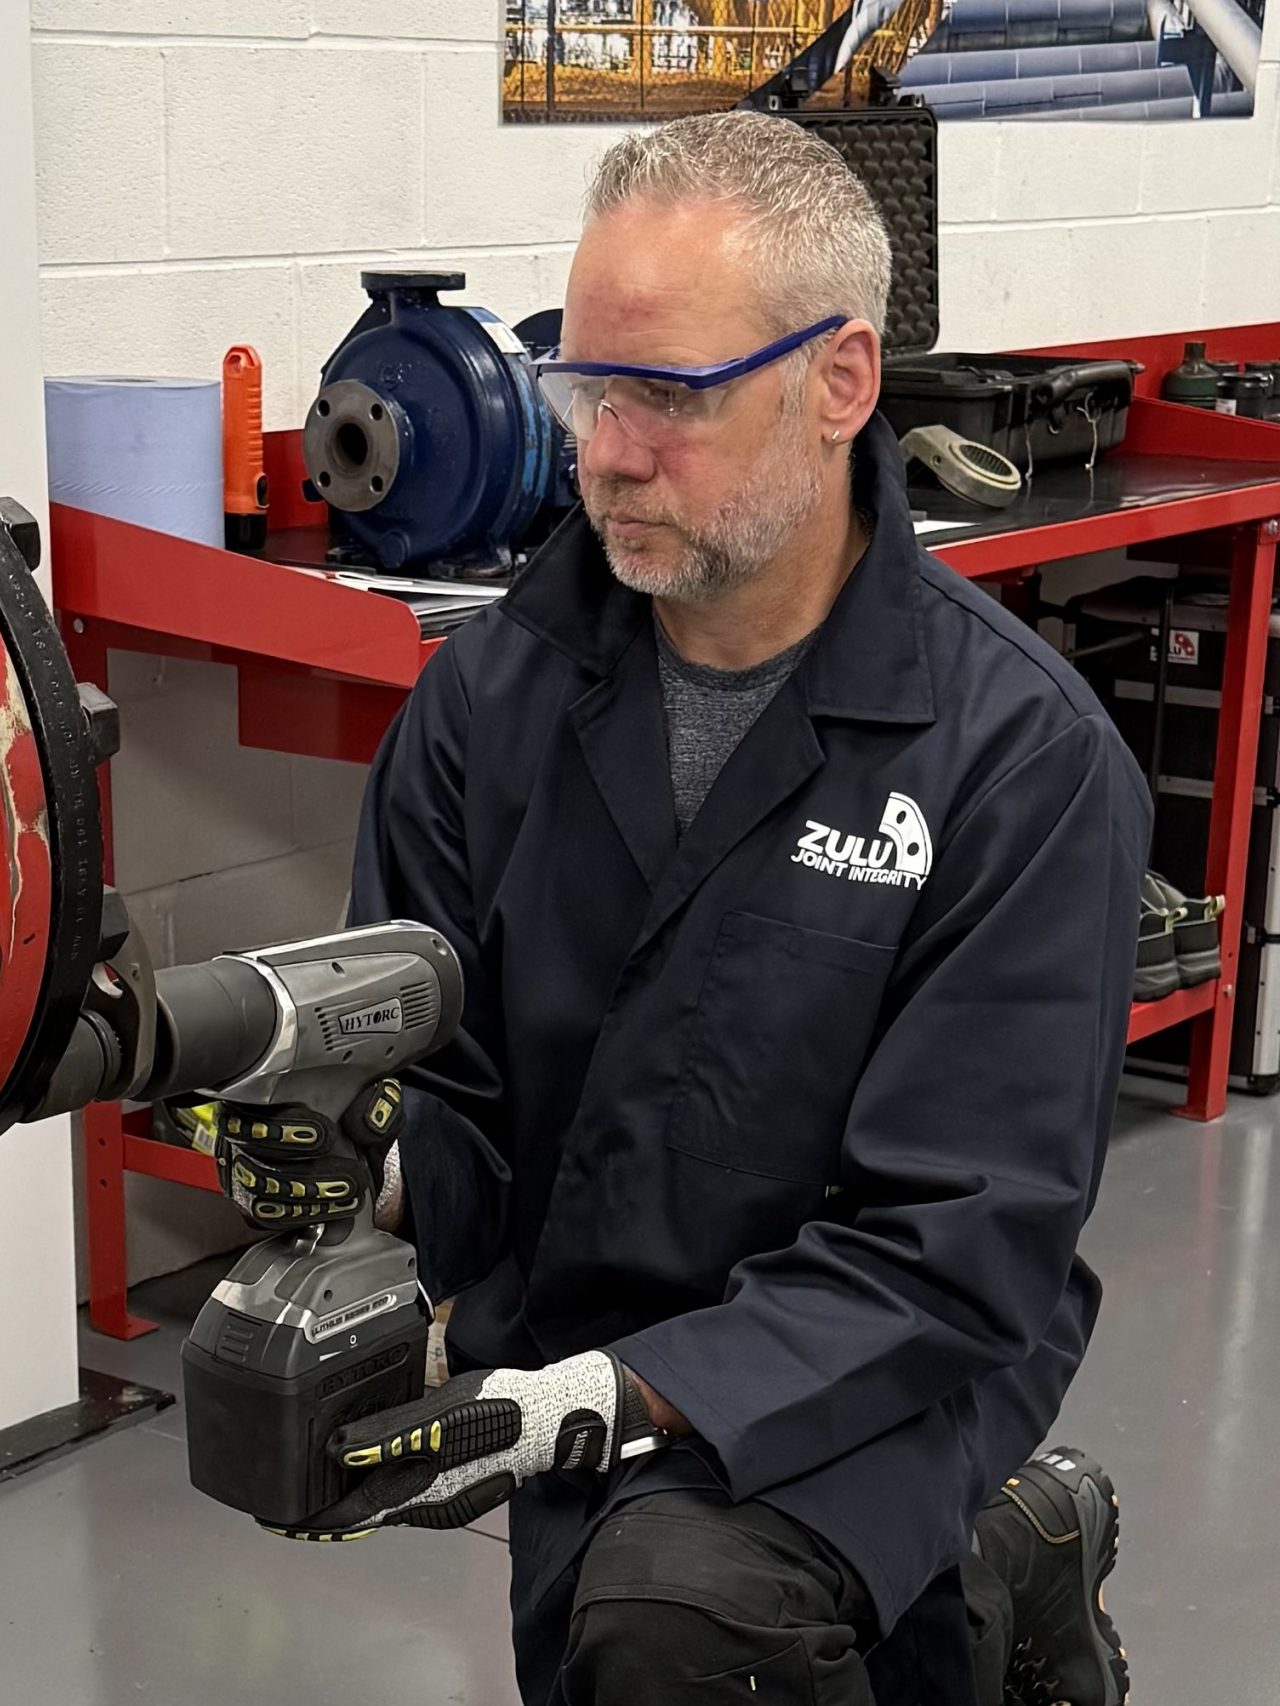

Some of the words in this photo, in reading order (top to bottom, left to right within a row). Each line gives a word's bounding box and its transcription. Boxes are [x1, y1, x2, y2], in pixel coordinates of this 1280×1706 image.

[797, 819, 894, 869] ZULU
[790, 849, 849, 878] JOINT
[848, 866, 928, 891] INTEGRITY
[345, 1006, 400, 1031] HYTORC
